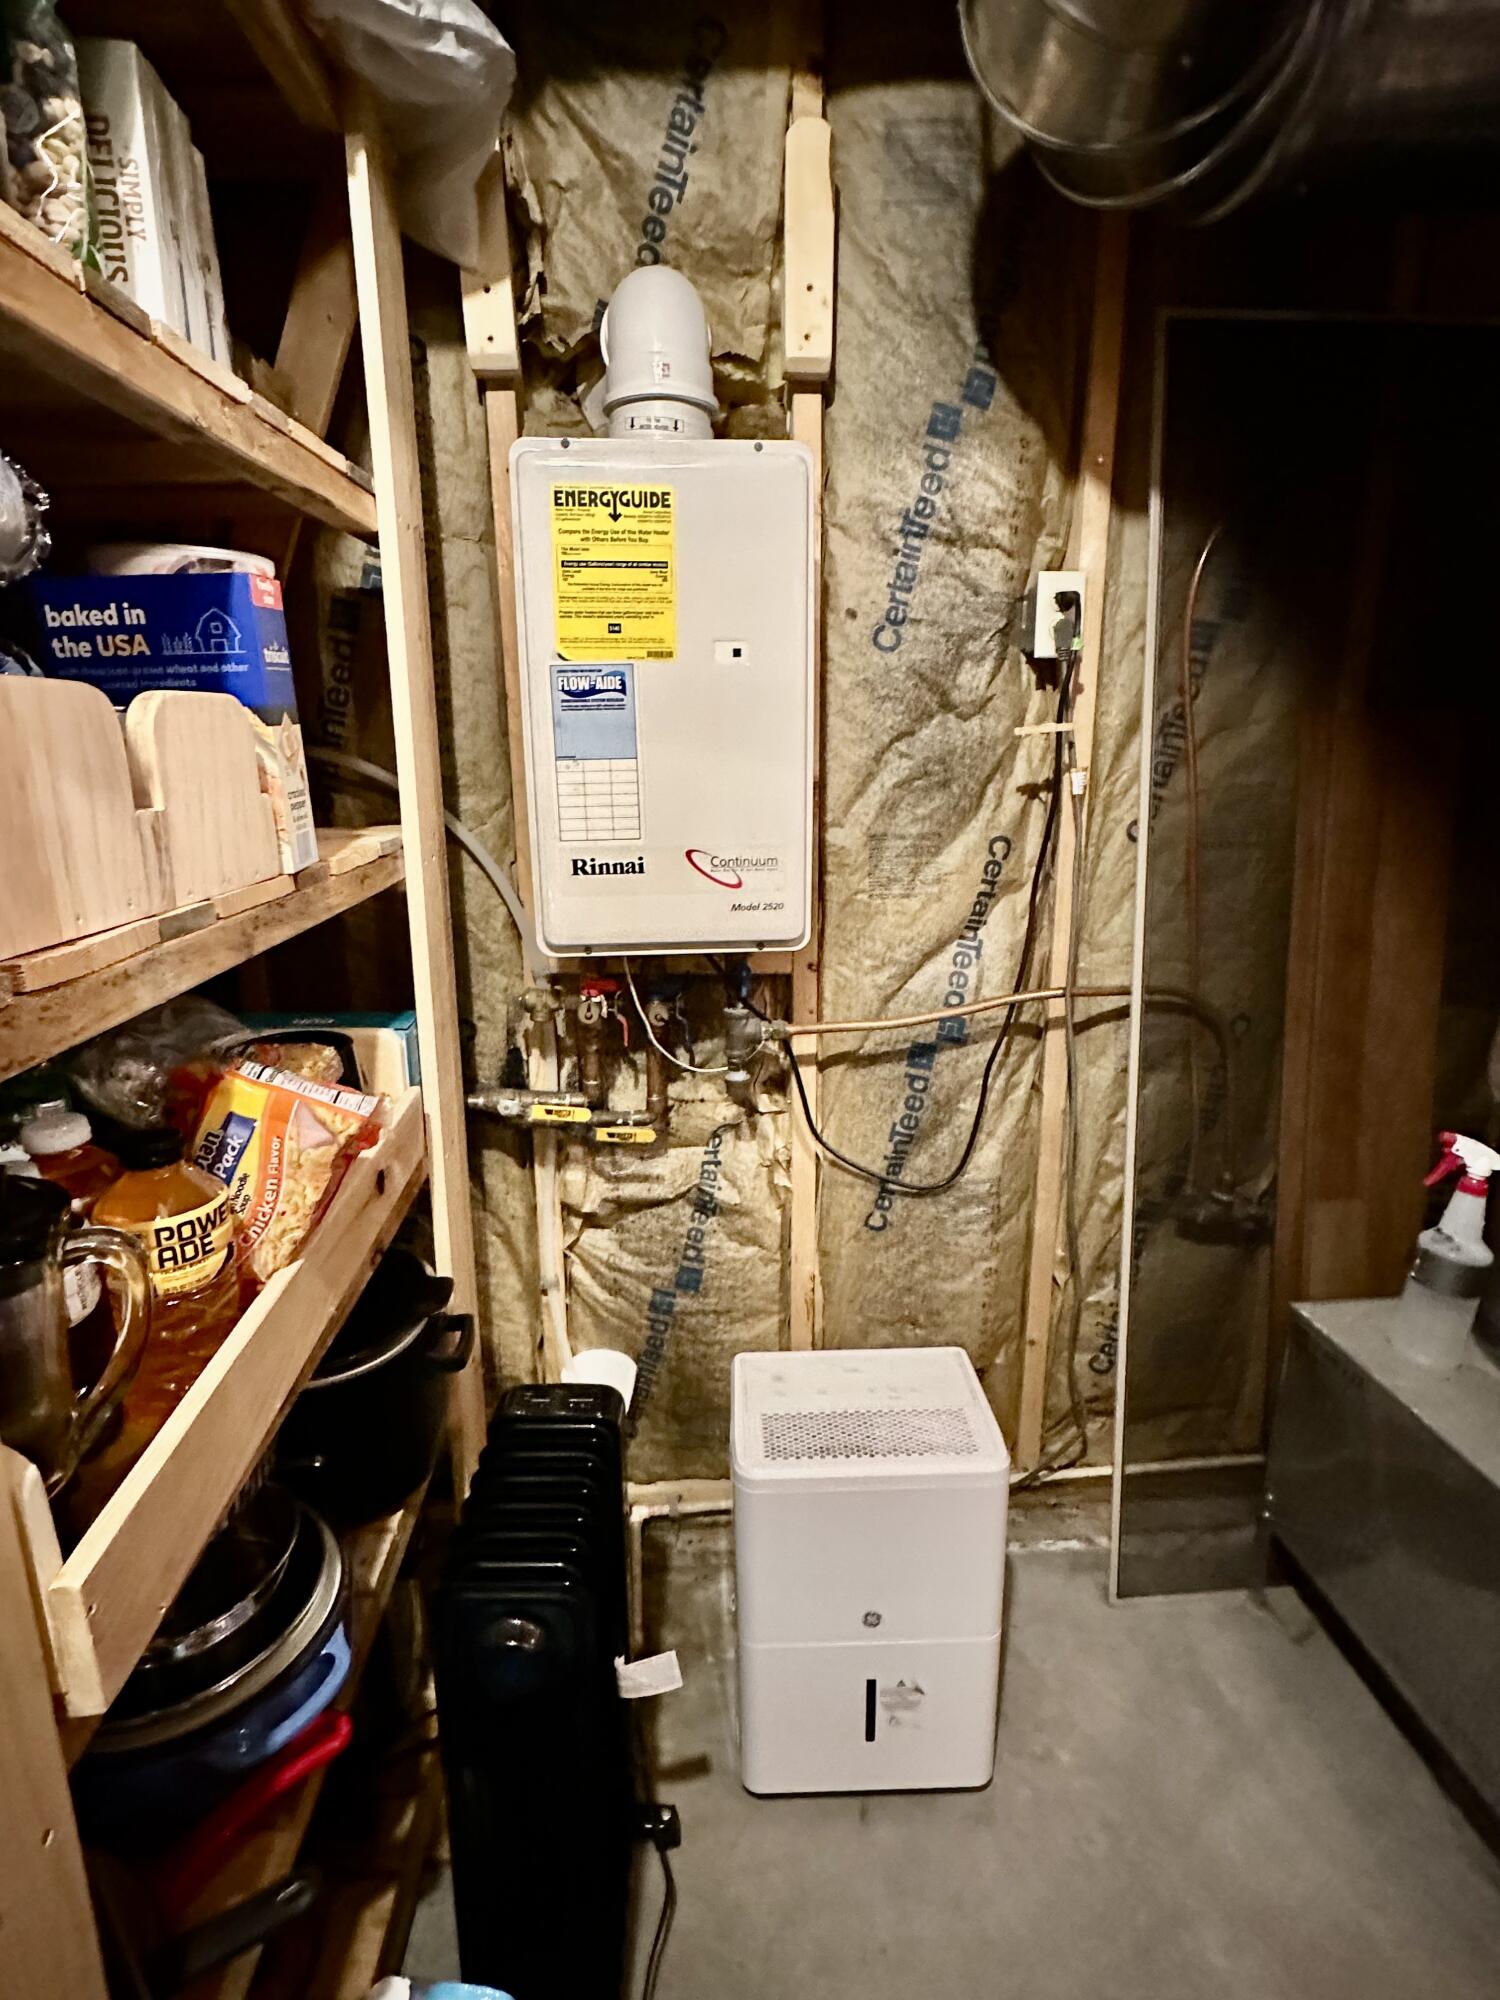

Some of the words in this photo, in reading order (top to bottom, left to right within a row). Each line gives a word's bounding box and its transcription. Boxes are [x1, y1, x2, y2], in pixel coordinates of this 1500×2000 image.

[117, 156, 146, 241] SIMPLY
[553, 489, 672, 509] ENERGYGUIDE
[872, 442, 951, 653] CertainTeed
[44, 603, 119, 628] baked
[123, 602, 147, 625] in
[51, 635, 92, 658] the
[96, 634, 151, 657] USA
[221, 662, 249, 673] other
[557, 675, 623, 691] FLOW-AIDE
[571, 856, 646, 876] Rinnai
[709, 855, 779, 868] Continuum
[731, 903, 760, 912] Model
[763, 902, 784, 911] 2520
[213, 1134, 245, 1179] Pack
[864, 1070, 930, 1232] CerainTeed
[239, 1178, 280, 1247] Chicken
[267, 1135, 284, 1175] Flavor
[683, 1132, 725, 1265] ertainTeed
[154, 1198, 230, 1248] POWE
[158, 1232, 216, 1269] ADE
